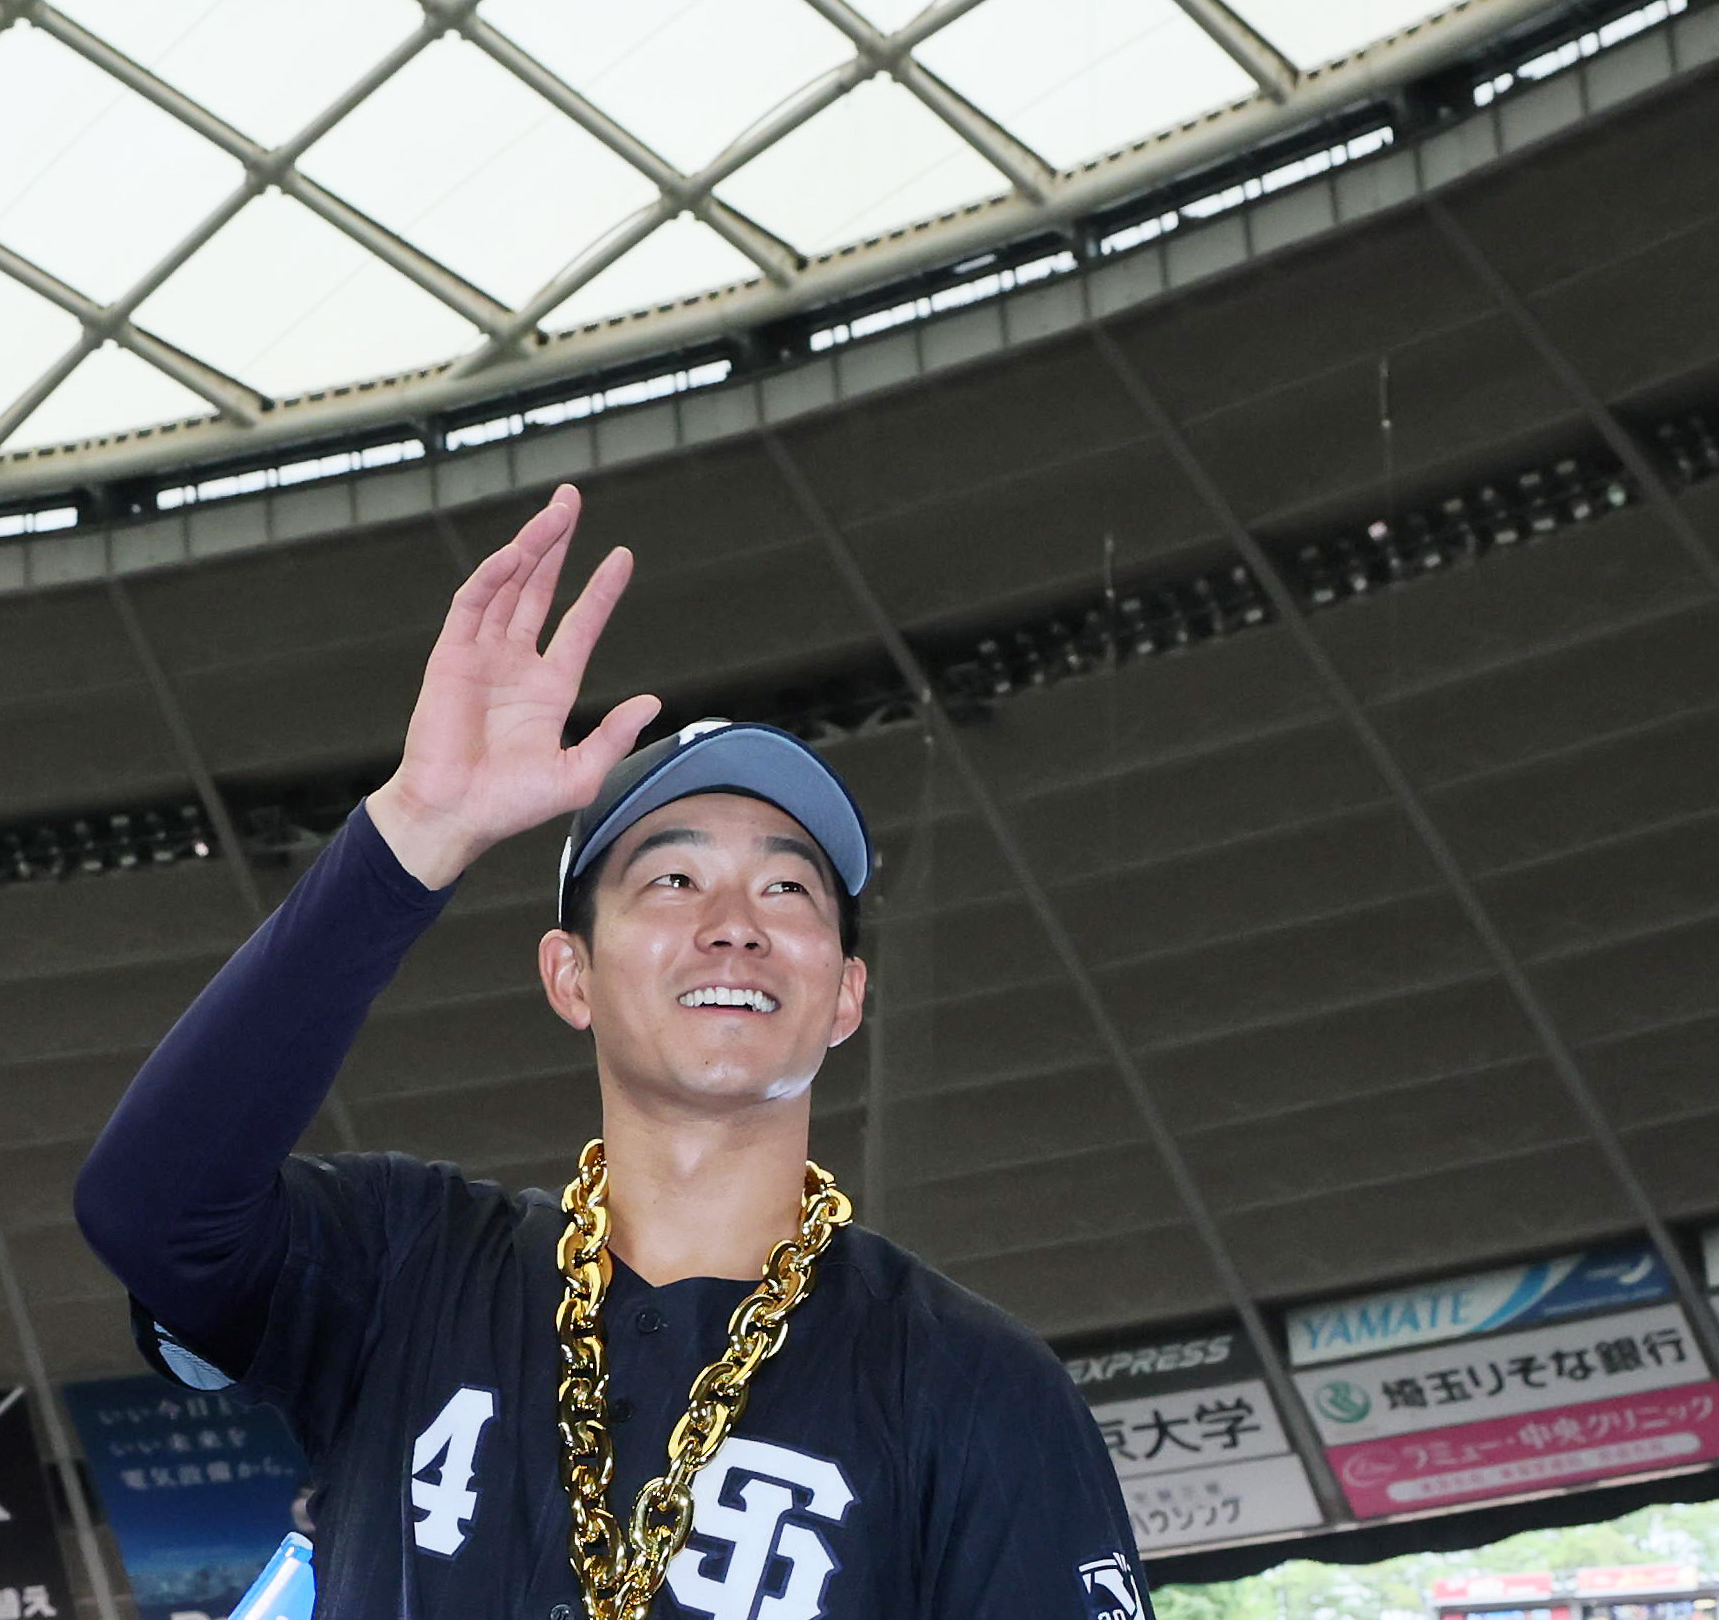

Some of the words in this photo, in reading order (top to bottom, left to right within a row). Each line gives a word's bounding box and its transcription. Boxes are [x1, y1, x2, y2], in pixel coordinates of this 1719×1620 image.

[1301, 1288, 1475, 1351] YAMATE
[1382, 1328, 1686, 1412] 埼玉りそな銀行
[410, 1385, 495, 1558] 4
